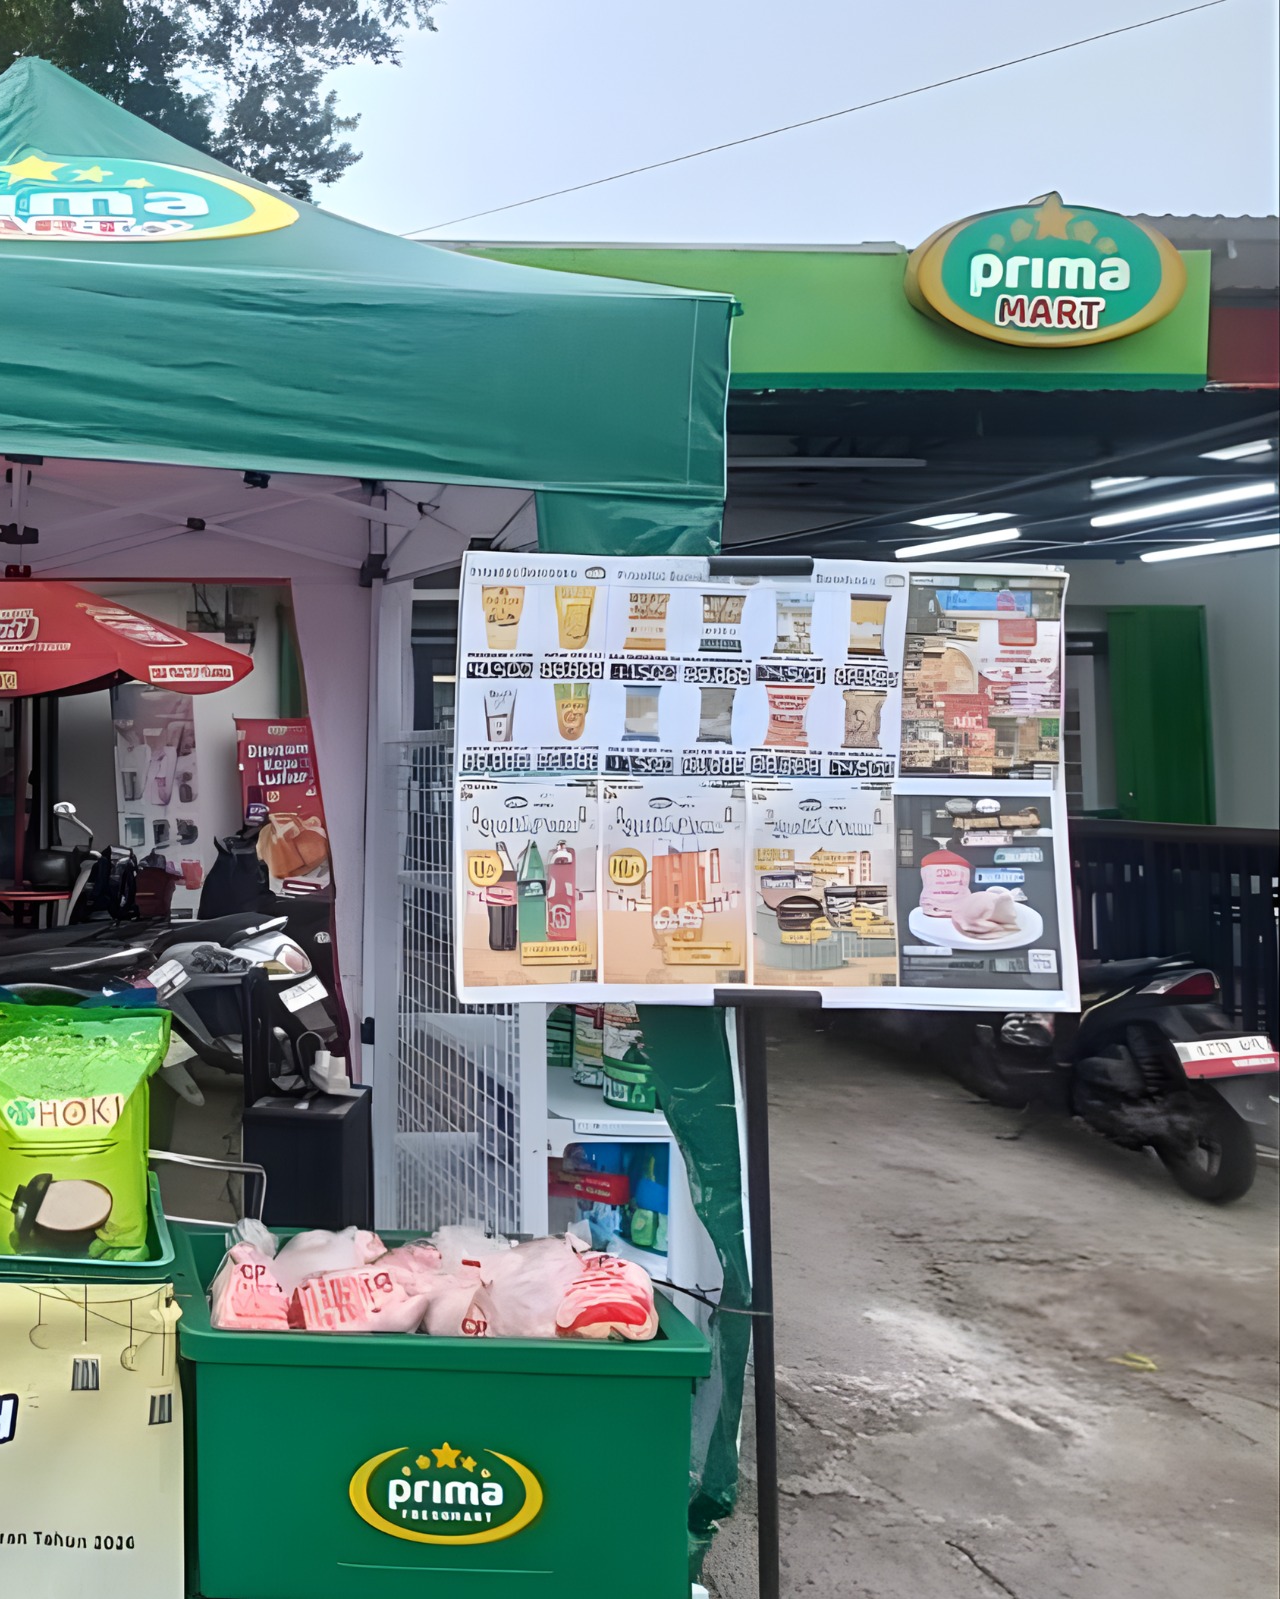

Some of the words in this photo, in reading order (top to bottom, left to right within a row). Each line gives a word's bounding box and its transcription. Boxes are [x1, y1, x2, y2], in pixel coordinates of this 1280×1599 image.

[970, 253, 1131, 298] prima
[995, 294, 1106, 331] MART
[388, 1478, 504, 1511] prima
